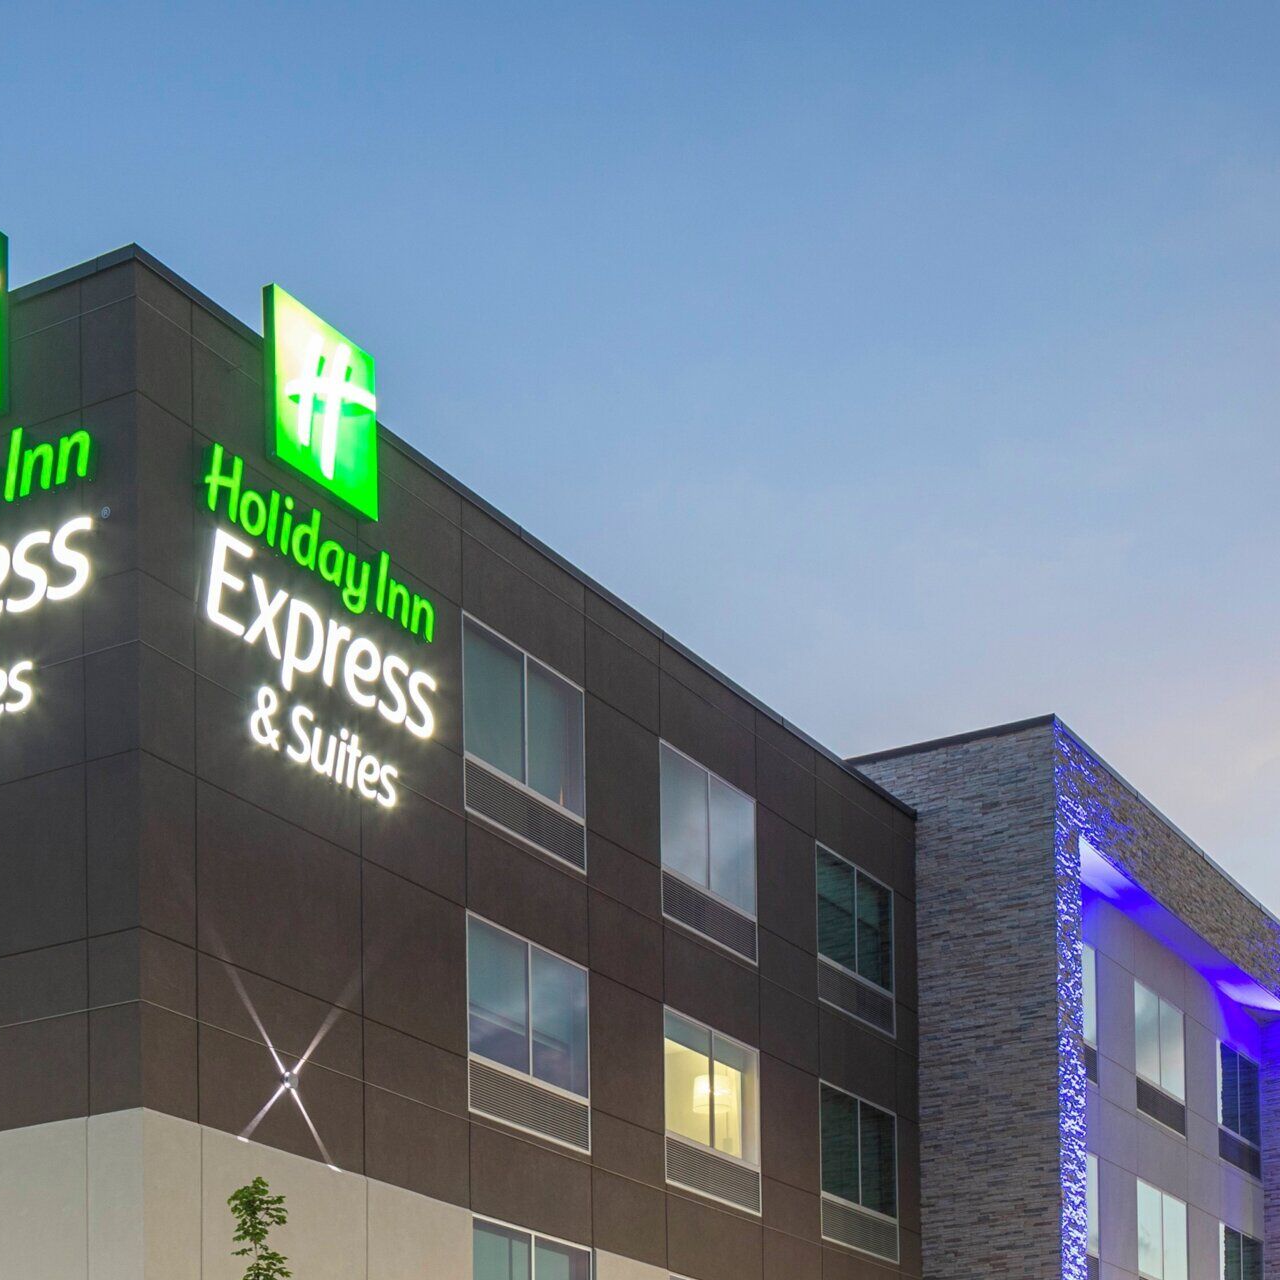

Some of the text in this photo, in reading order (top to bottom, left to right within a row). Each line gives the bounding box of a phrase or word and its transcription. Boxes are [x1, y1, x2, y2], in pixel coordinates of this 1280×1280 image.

[3, 427, 91, 503] Inn
[204, 442, 435, 643] Holiday Inn
[205, 527, 437, 740] Express
[248, 685, 399, 808] & Suites
